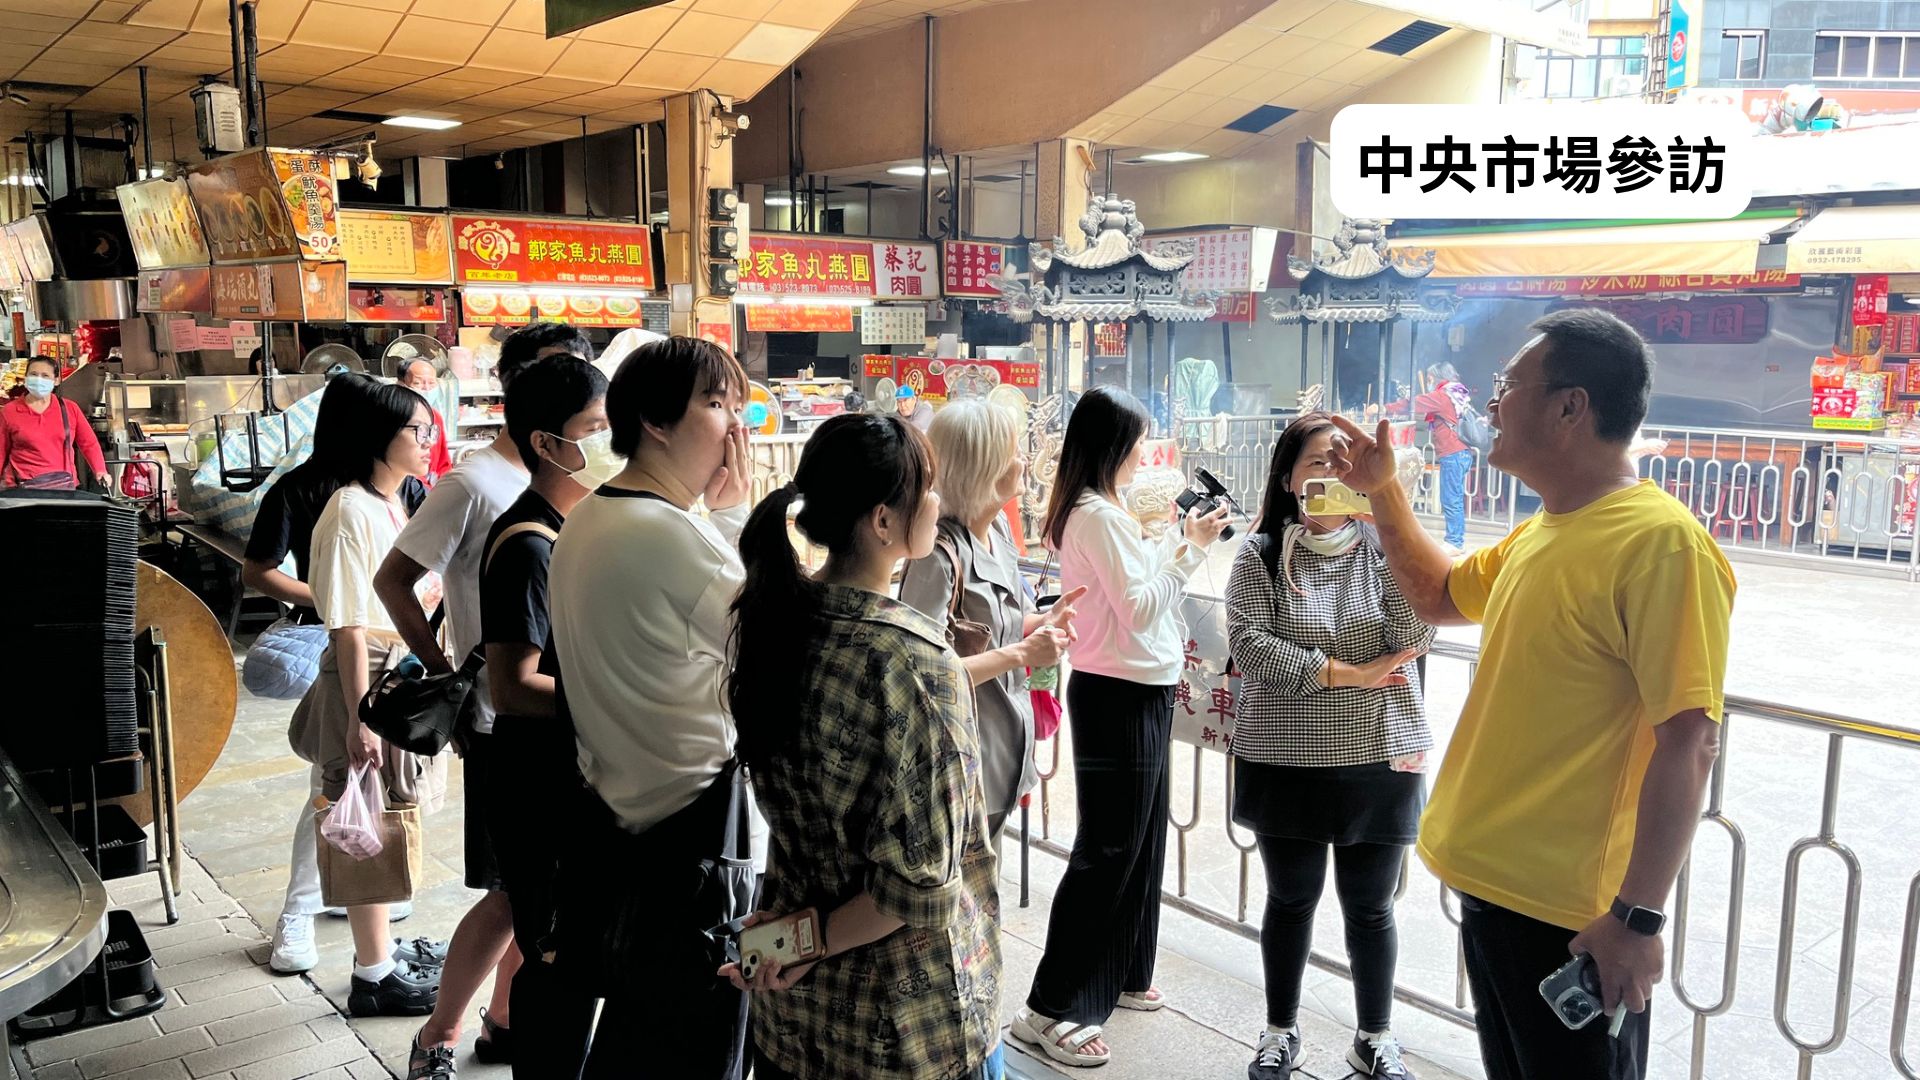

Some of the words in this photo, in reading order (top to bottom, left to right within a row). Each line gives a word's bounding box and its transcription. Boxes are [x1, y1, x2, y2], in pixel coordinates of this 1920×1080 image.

[311, 237, 329, 248] 50
[527, 239, 643, 267] 鄭家魚丸燕圓
[884, 245, 927, 273] 蔡記
[891, 276, 922, 296] 肉圓
